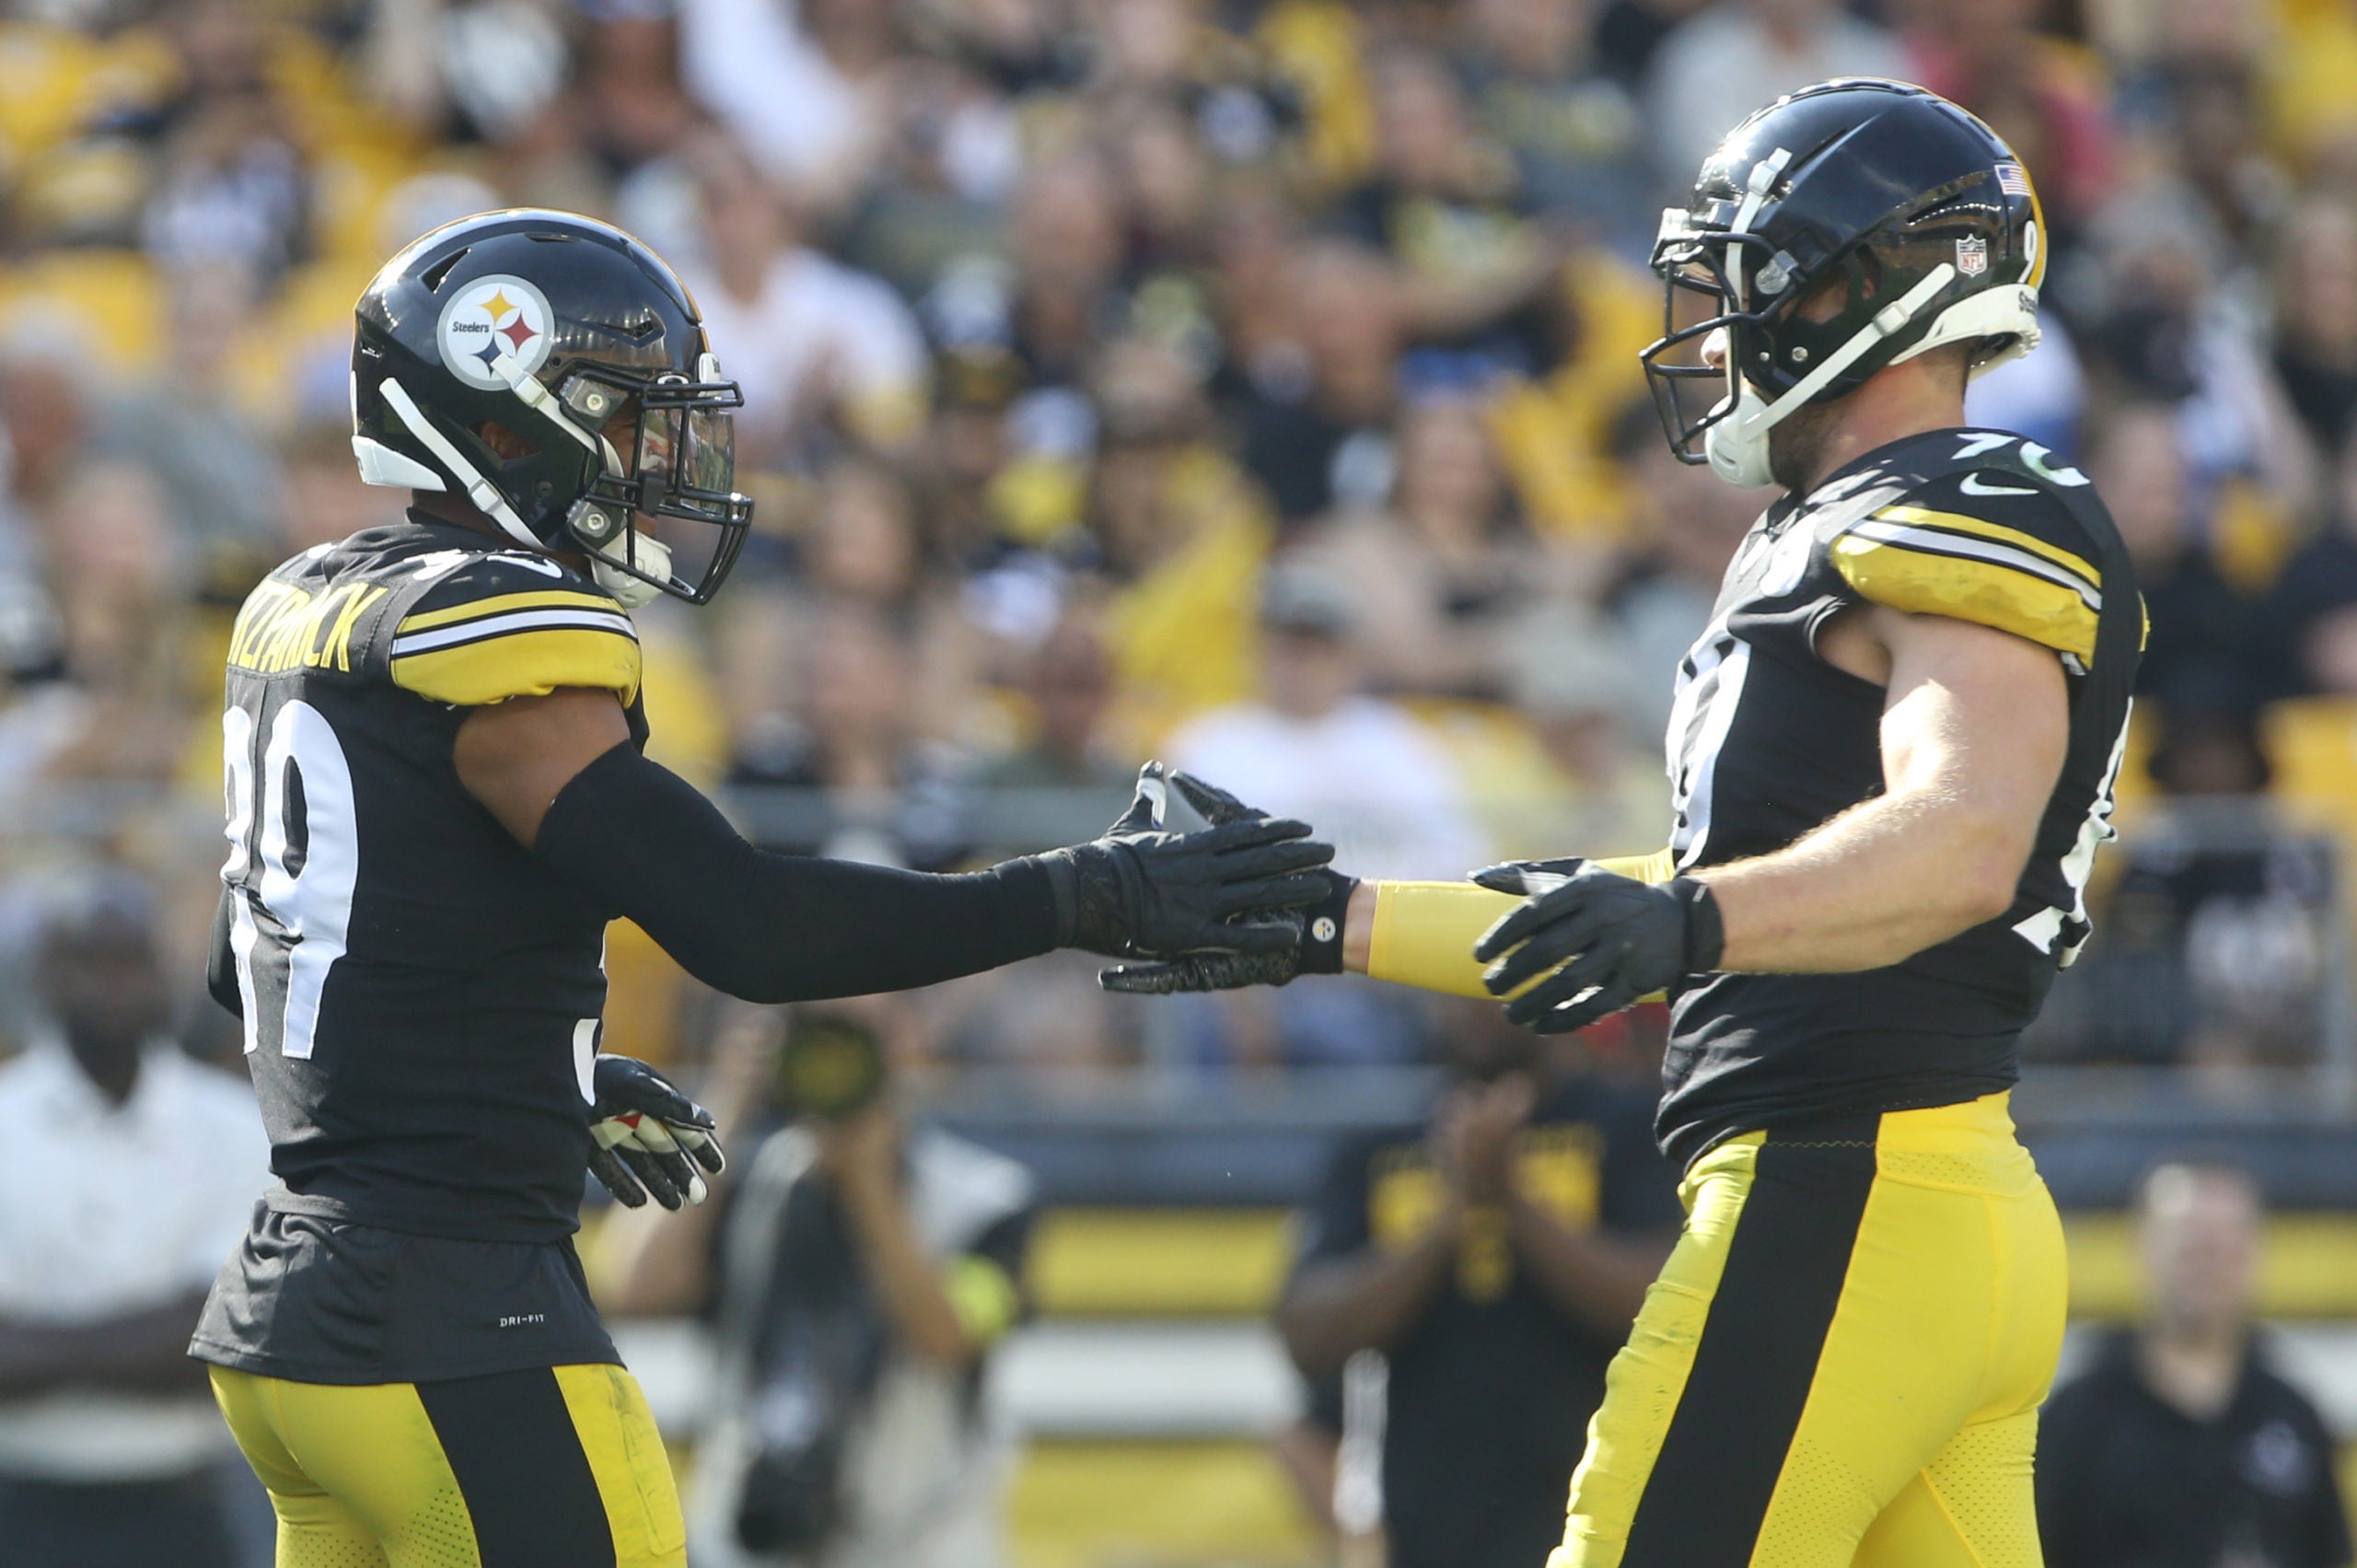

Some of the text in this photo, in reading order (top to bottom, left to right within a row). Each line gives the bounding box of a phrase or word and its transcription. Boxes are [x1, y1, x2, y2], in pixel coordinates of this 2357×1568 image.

[1962, 253, 1984, 270] NFL
[453, 321, 490, 332] Steelers
[500, 1314, 544, 1327] DRI-FIT
